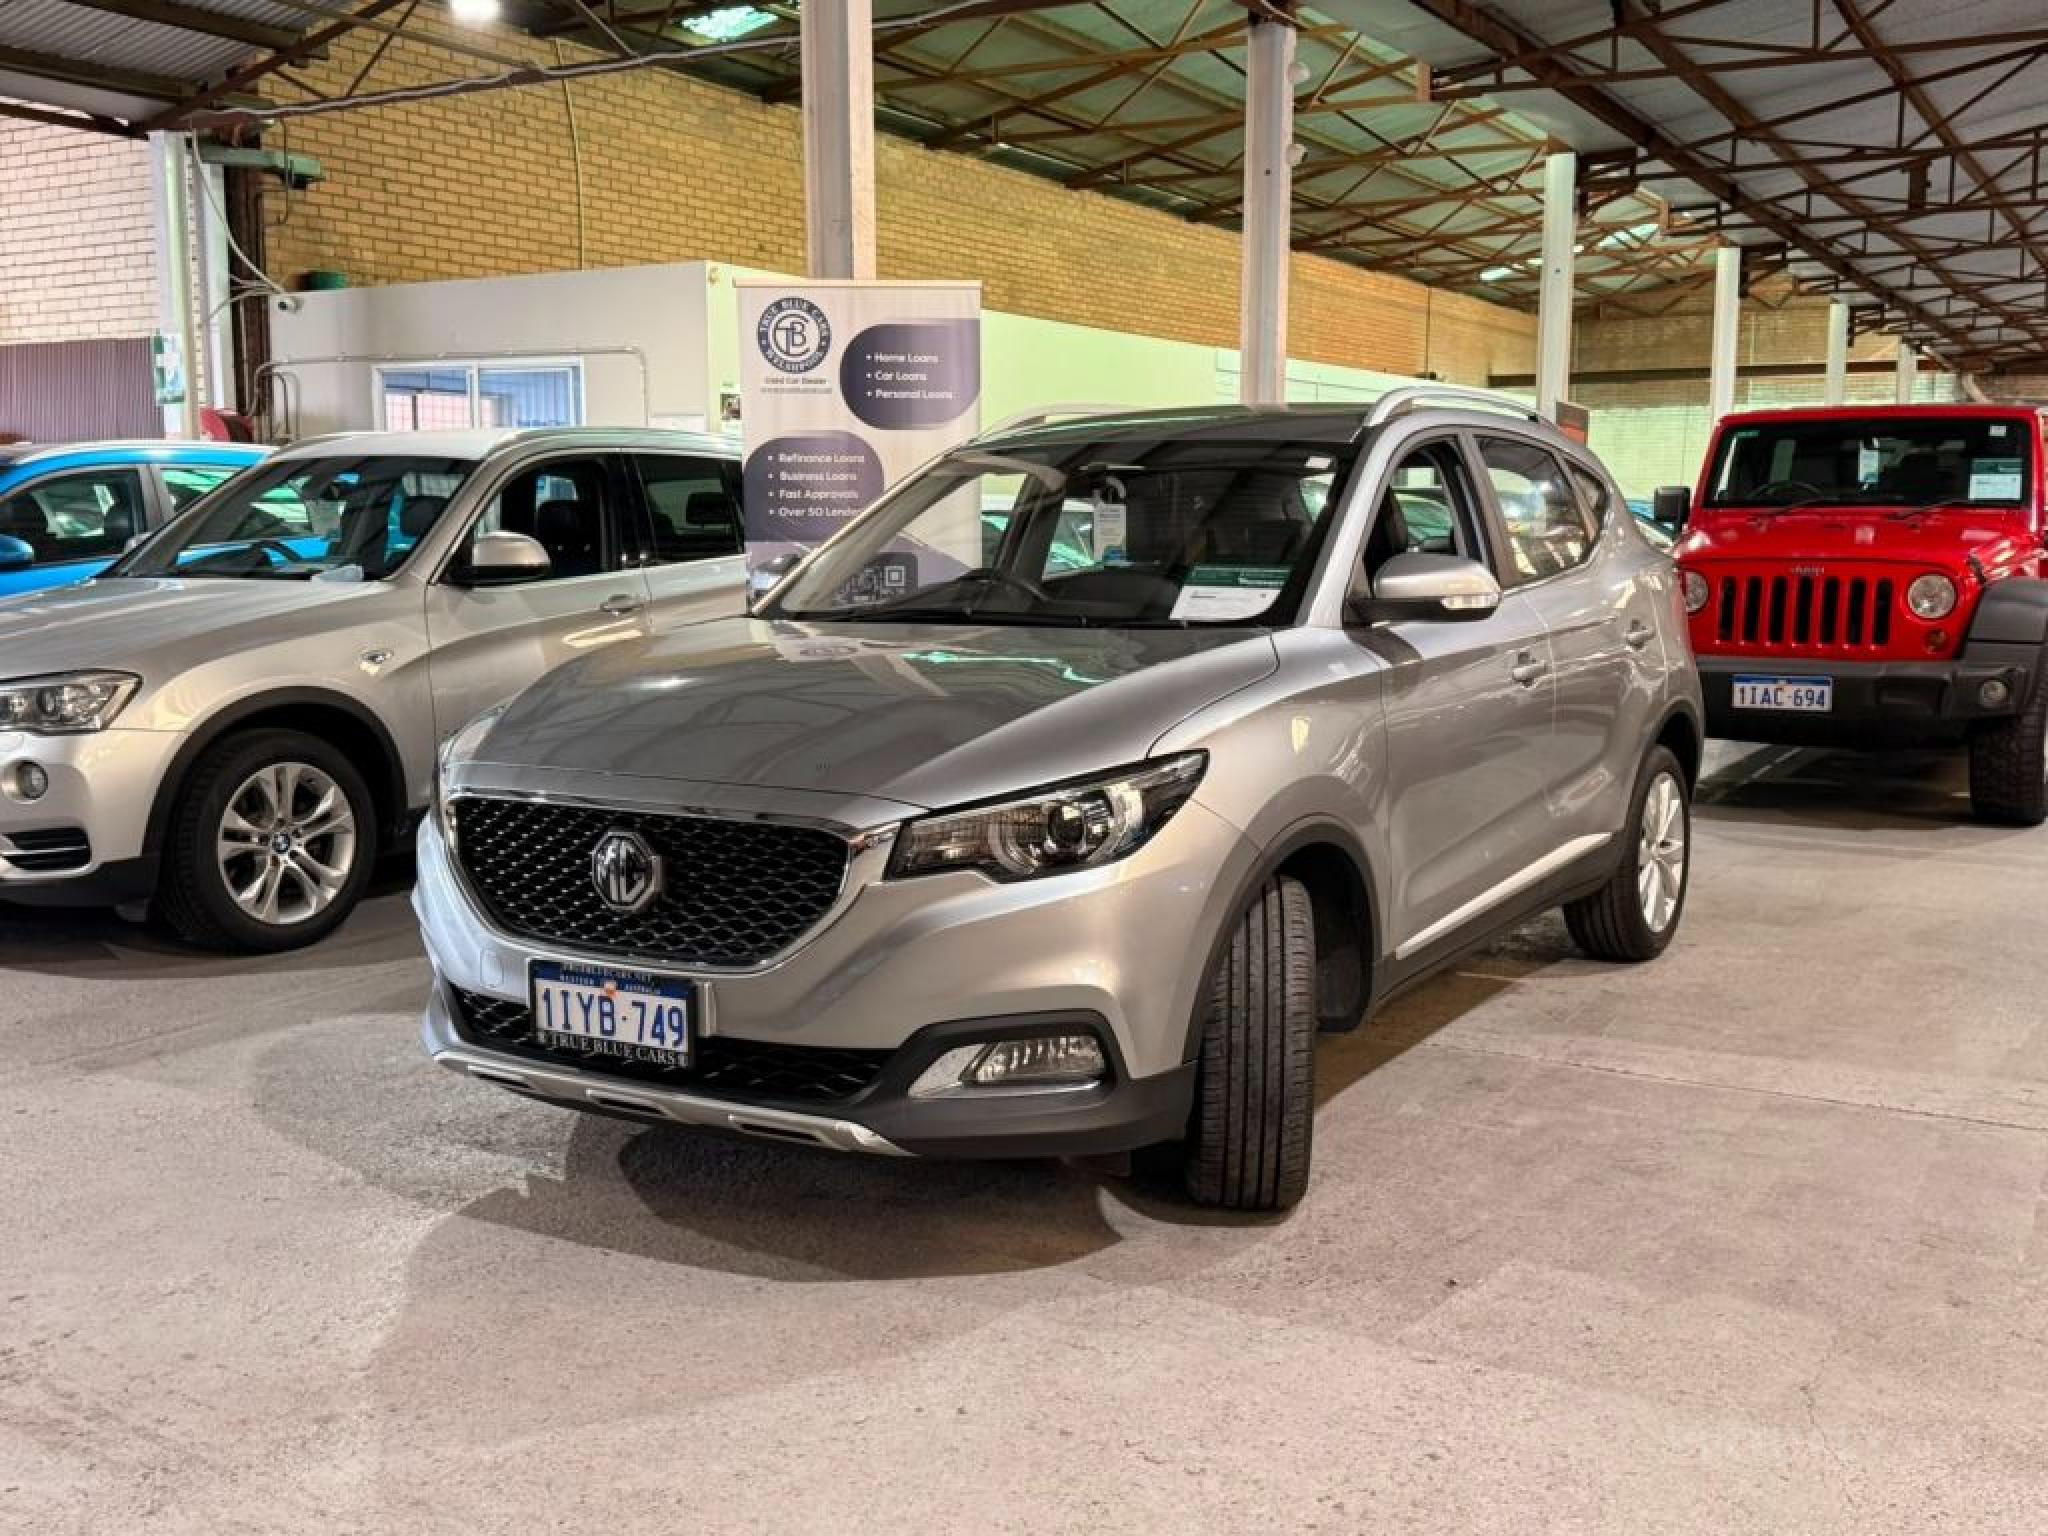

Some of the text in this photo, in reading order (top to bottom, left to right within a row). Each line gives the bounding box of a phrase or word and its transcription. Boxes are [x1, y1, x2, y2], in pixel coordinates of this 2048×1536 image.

[874, 353, 939, 362] Home Loans
[875, 370, 927, 380] Car Loans
[876, 388, 953, 398] Personal Loans
[779, 453, 864, 462] Refinance Loans
[780, 472, 857, 480] Business Loans
[780, 489, 801, 499] Fast
[779, 507, 804, 516] Over
[808, 507, 822, 516] 50
[597, 838, 646, 903] MG
[592, 1039, 635, 1059] BLUE
[636, 1047, 676, 1066] CARS
